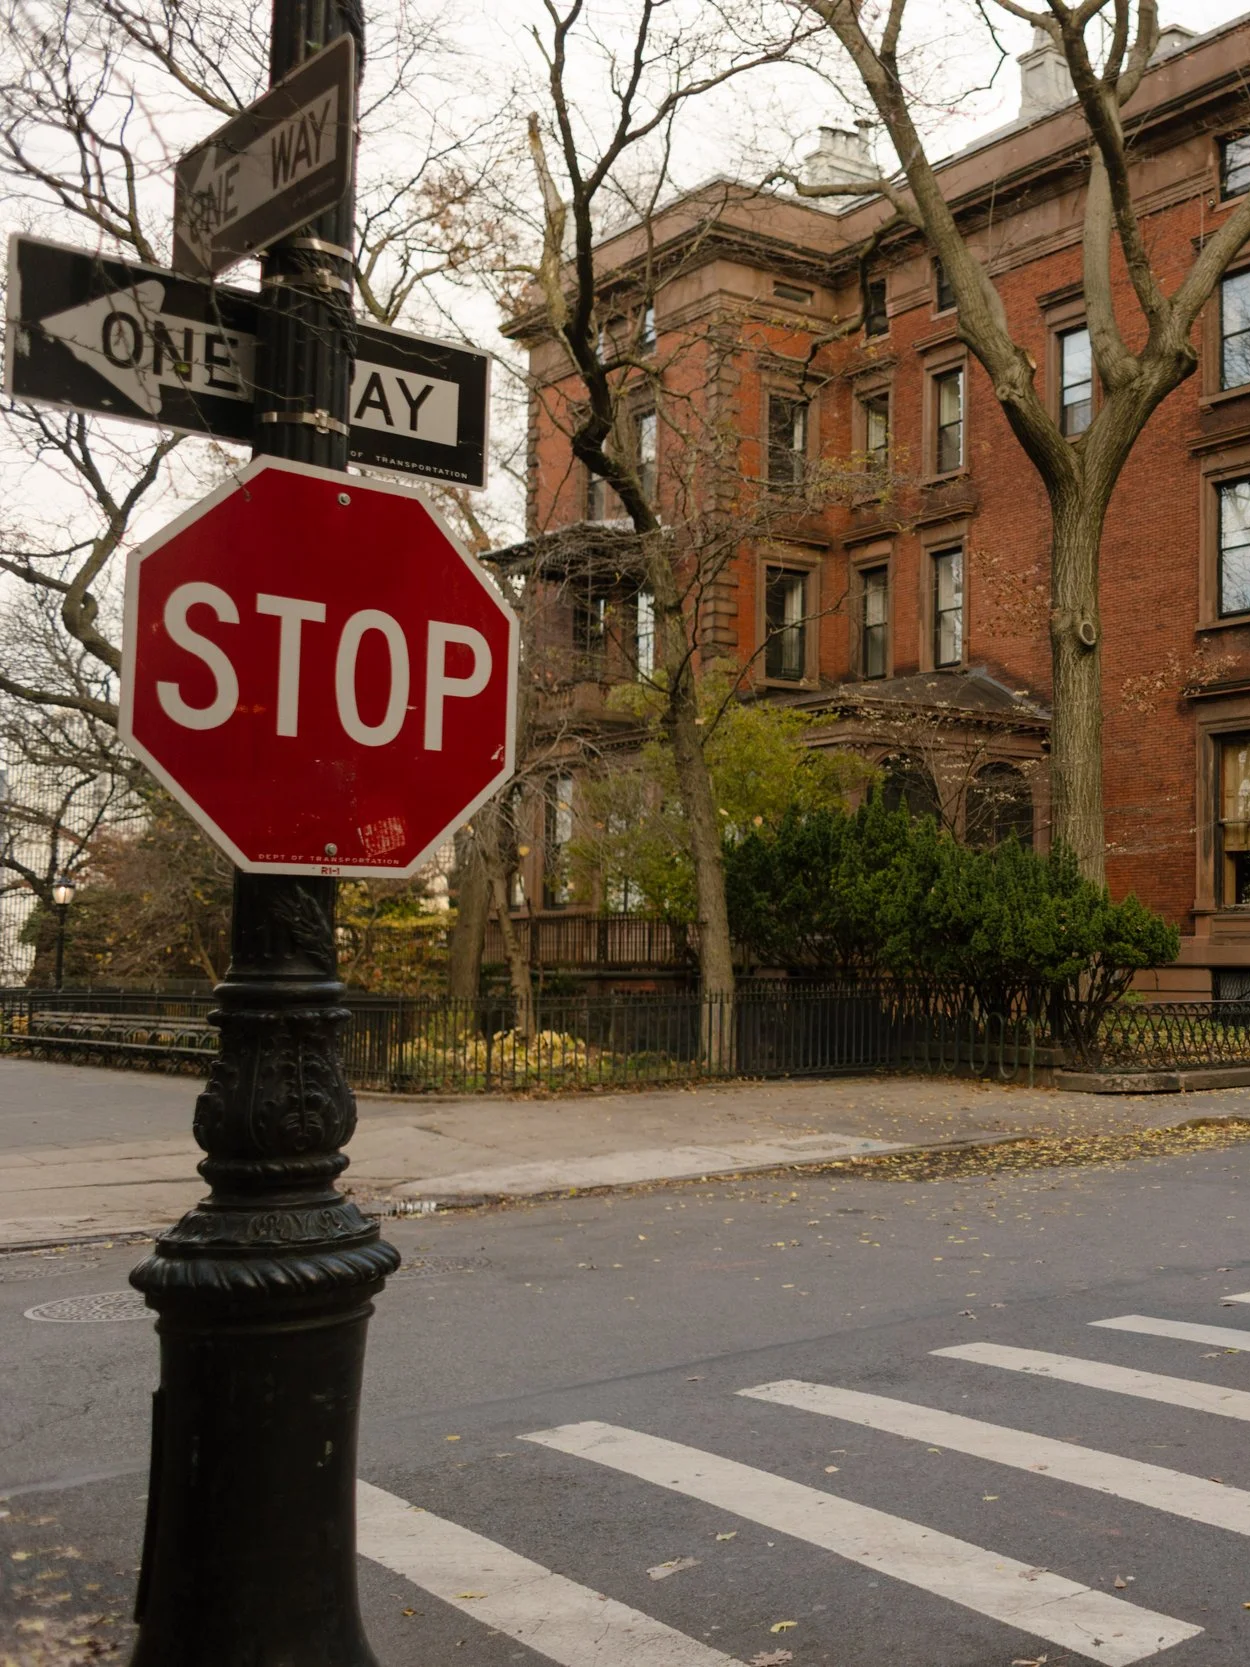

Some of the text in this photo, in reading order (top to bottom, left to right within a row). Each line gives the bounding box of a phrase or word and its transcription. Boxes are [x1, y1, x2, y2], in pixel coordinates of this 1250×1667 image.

[271, 98, 332, 190] WAY
[102, 311, 434, 432] ONE AY
[350, 450, 468, 480] OF TRANSPORTATION
[156, 581, 493, 752] STOP
[258, 853, 285, 861] DEPT
[310, 855, 400, 865] TRANSPORTATION
